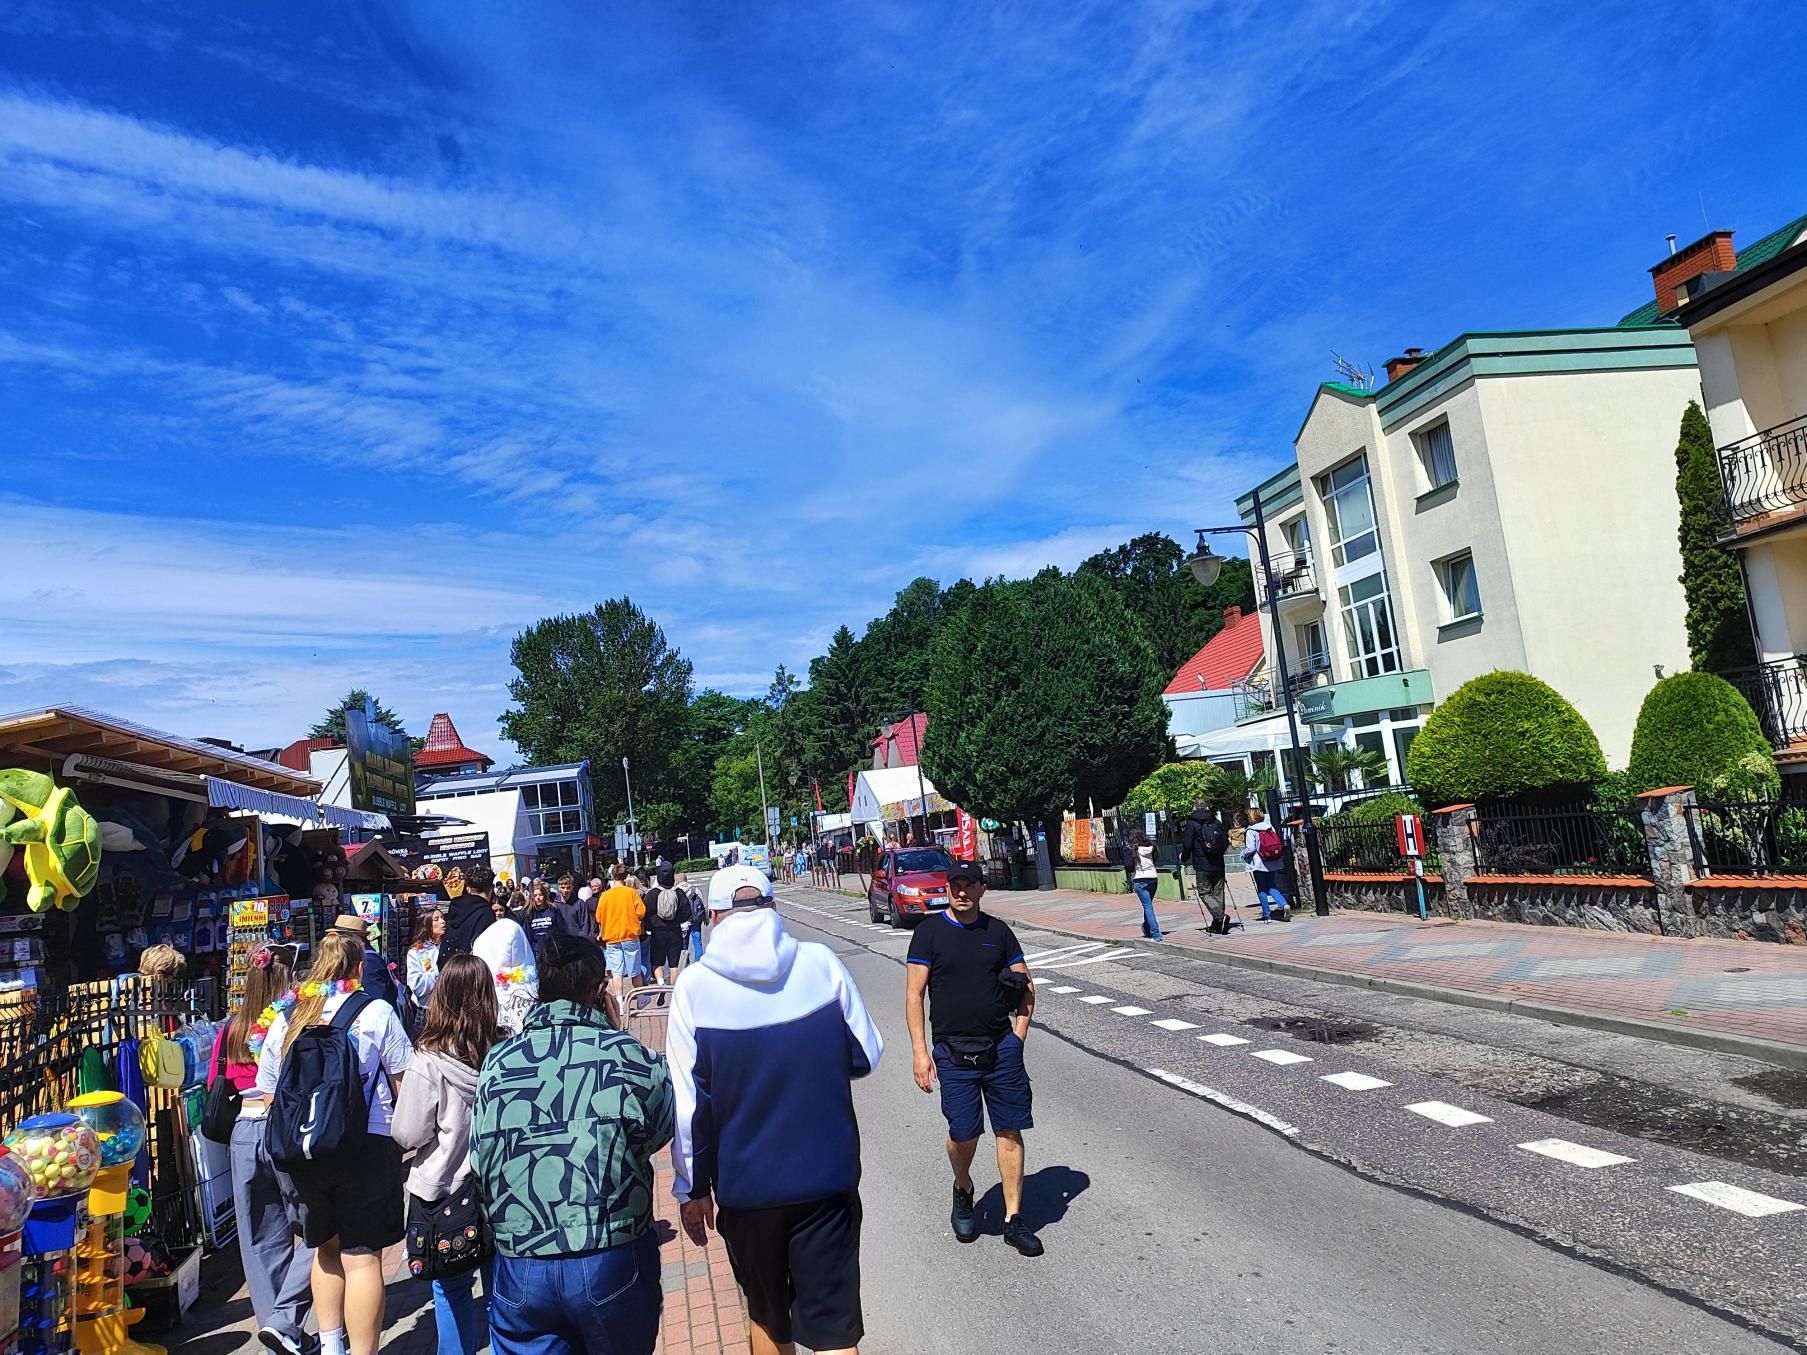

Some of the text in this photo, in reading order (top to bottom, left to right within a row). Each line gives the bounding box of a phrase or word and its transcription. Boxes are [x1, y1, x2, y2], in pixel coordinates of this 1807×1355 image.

[1298, 700, 1327, 714] Dominik
[961, 811, 971, 848] TYSK
[1403, 819, 1417, 851] H
[253, 901, 265, 912] 10
[361, 901, 370, 913] 7
[240, 913, 267, 922] IMIENNE
